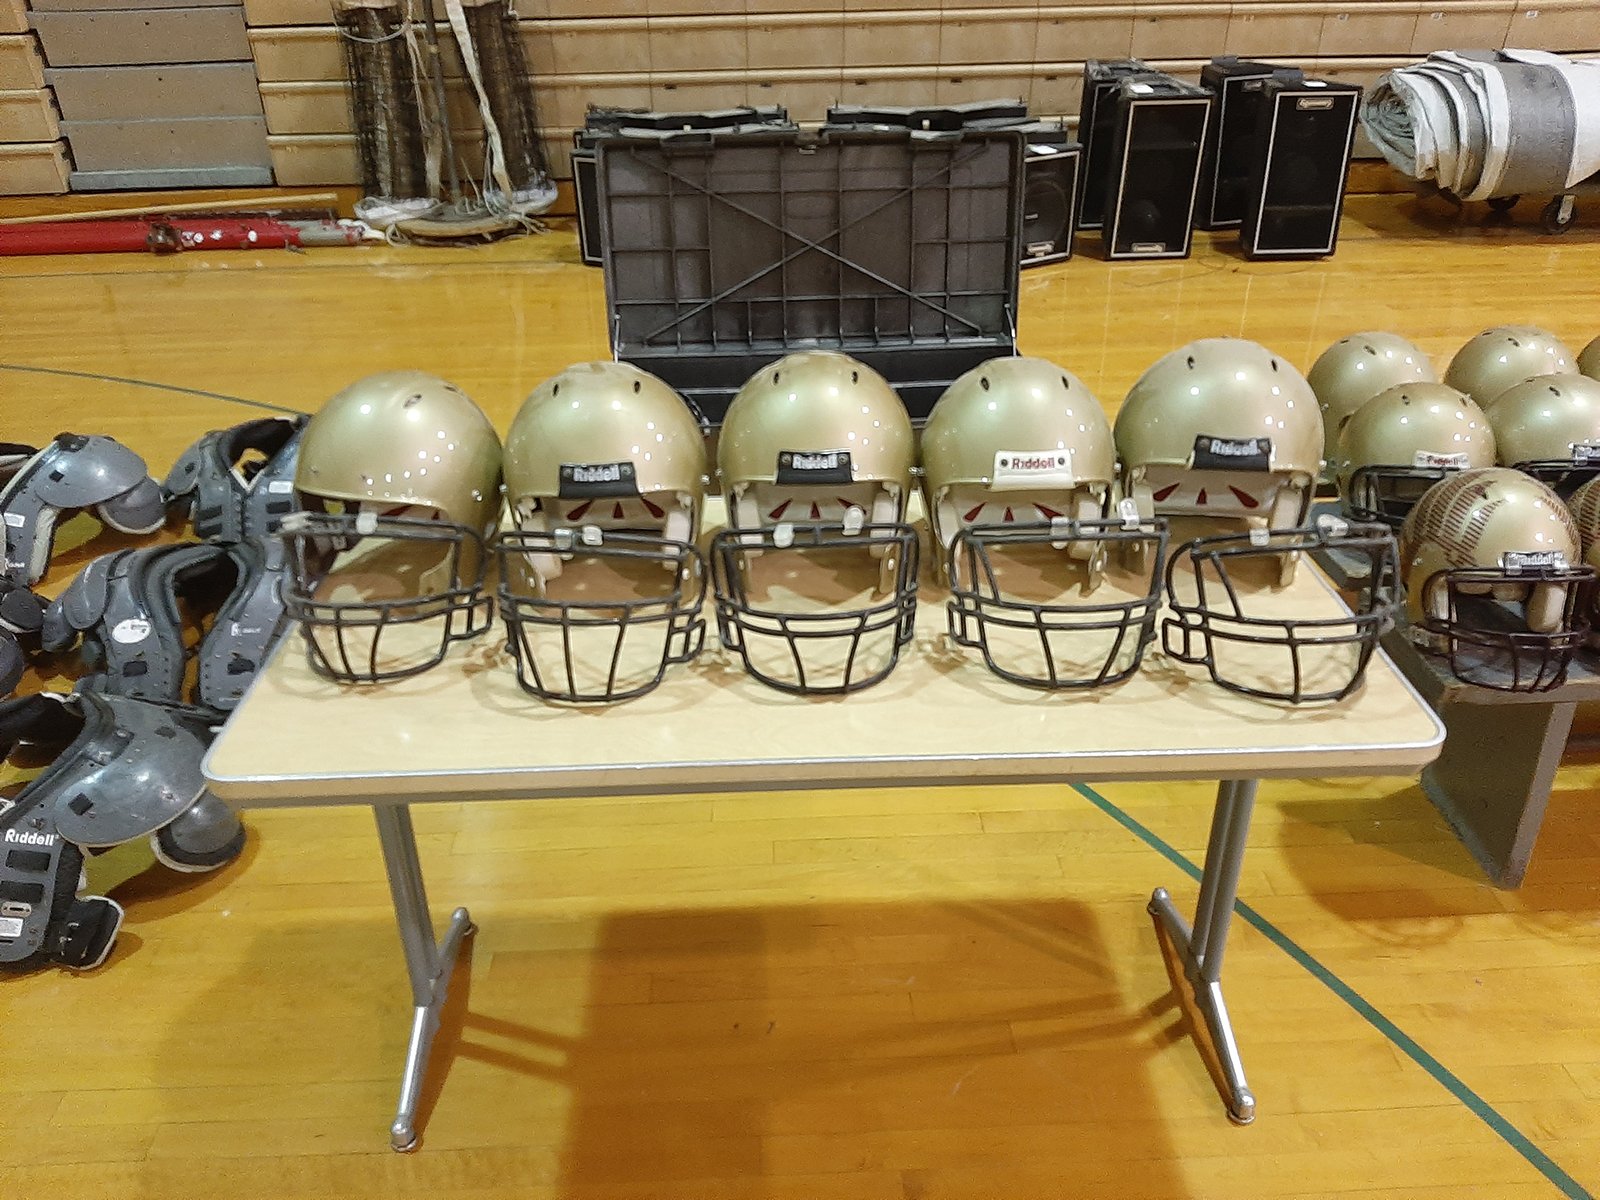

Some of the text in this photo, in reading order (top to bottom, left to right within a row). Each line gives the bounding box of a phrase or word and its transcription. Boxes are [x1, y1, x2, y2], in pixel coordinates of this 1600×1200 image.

[792, 454, 838, 469] Riddell
[1011, 457, 1055, 470] Riddell
[573, 466, 621, 482] Riddell
[5, 828, 54, 846] Riddell
